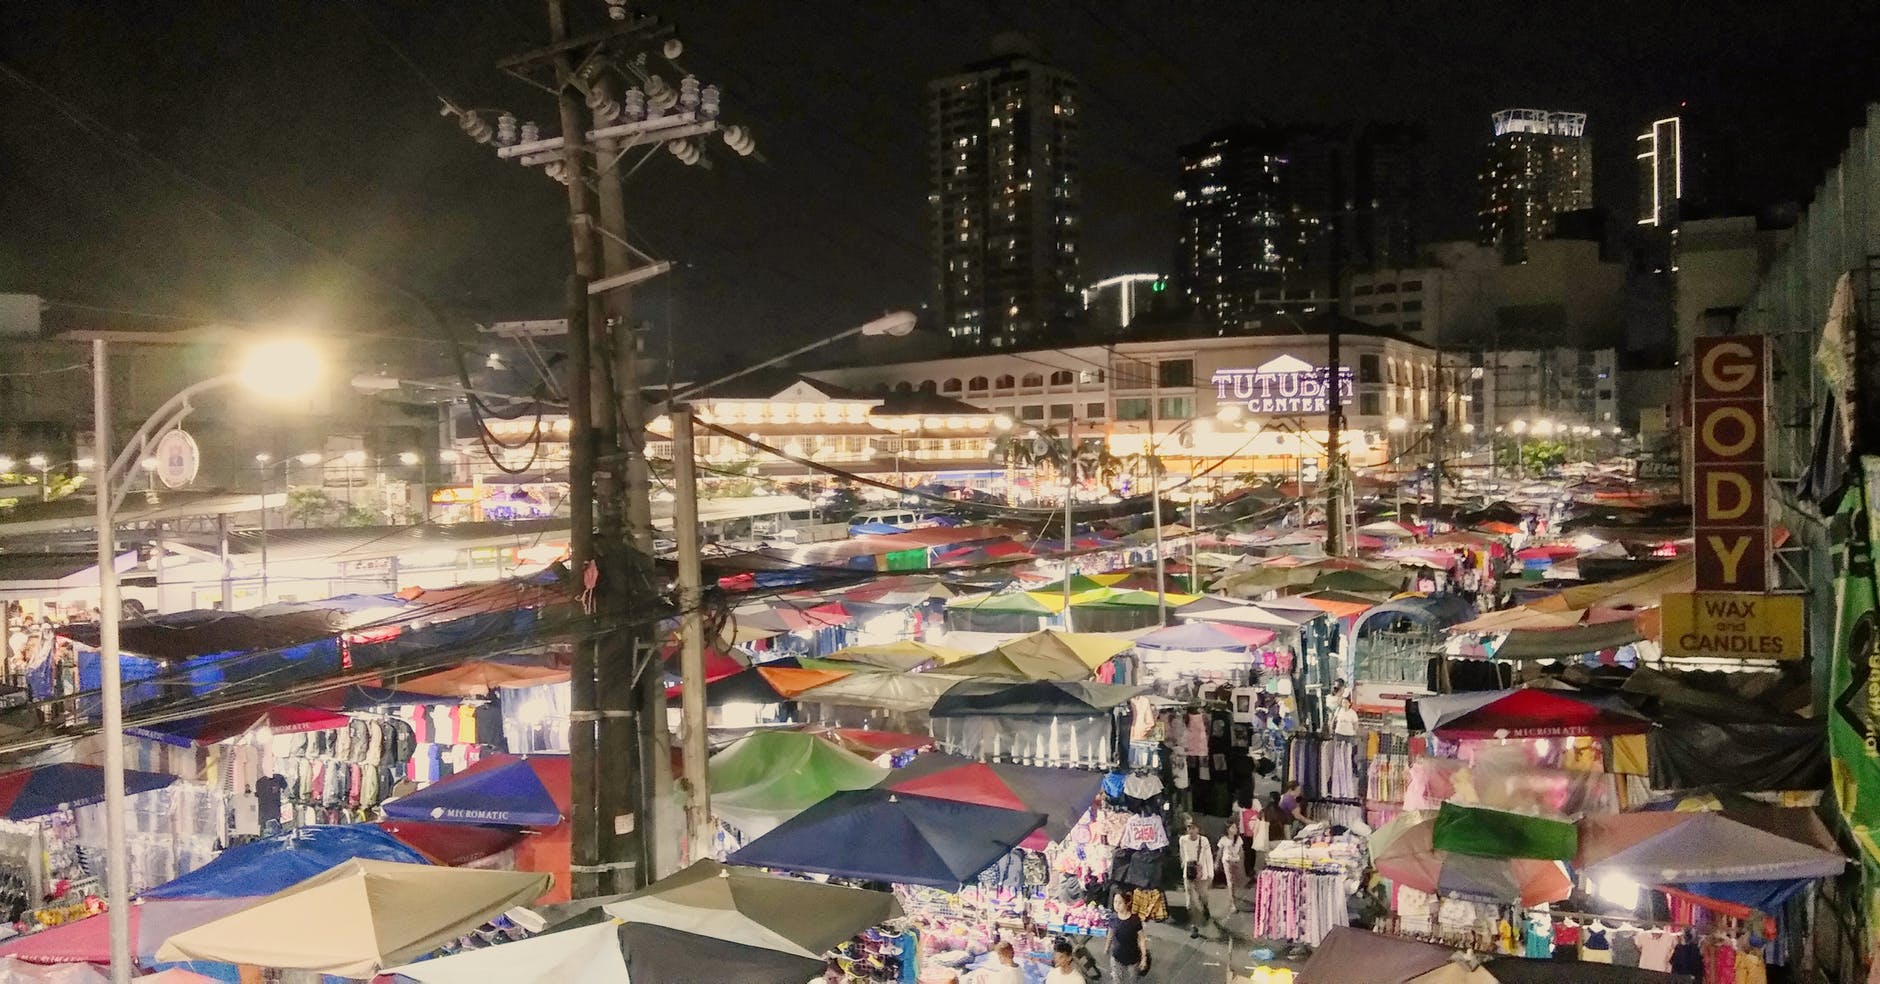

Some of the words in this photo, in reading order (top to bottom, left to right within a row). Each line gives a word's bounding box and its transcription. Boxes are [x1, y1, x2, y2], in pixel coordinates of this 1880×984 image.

[1248, 398, 1326, 412] CENTER
[1702, 342, 1757, 583] GODY
[1705, 601, 1756, 618] WAX
[1717, 622, 1746, 632] and
[1679, 634, 1783, 653] CANDLES
[1513, 727, 1589, 737] MICROMATIC
[447, 809, 509, 820] MICROMATIC
